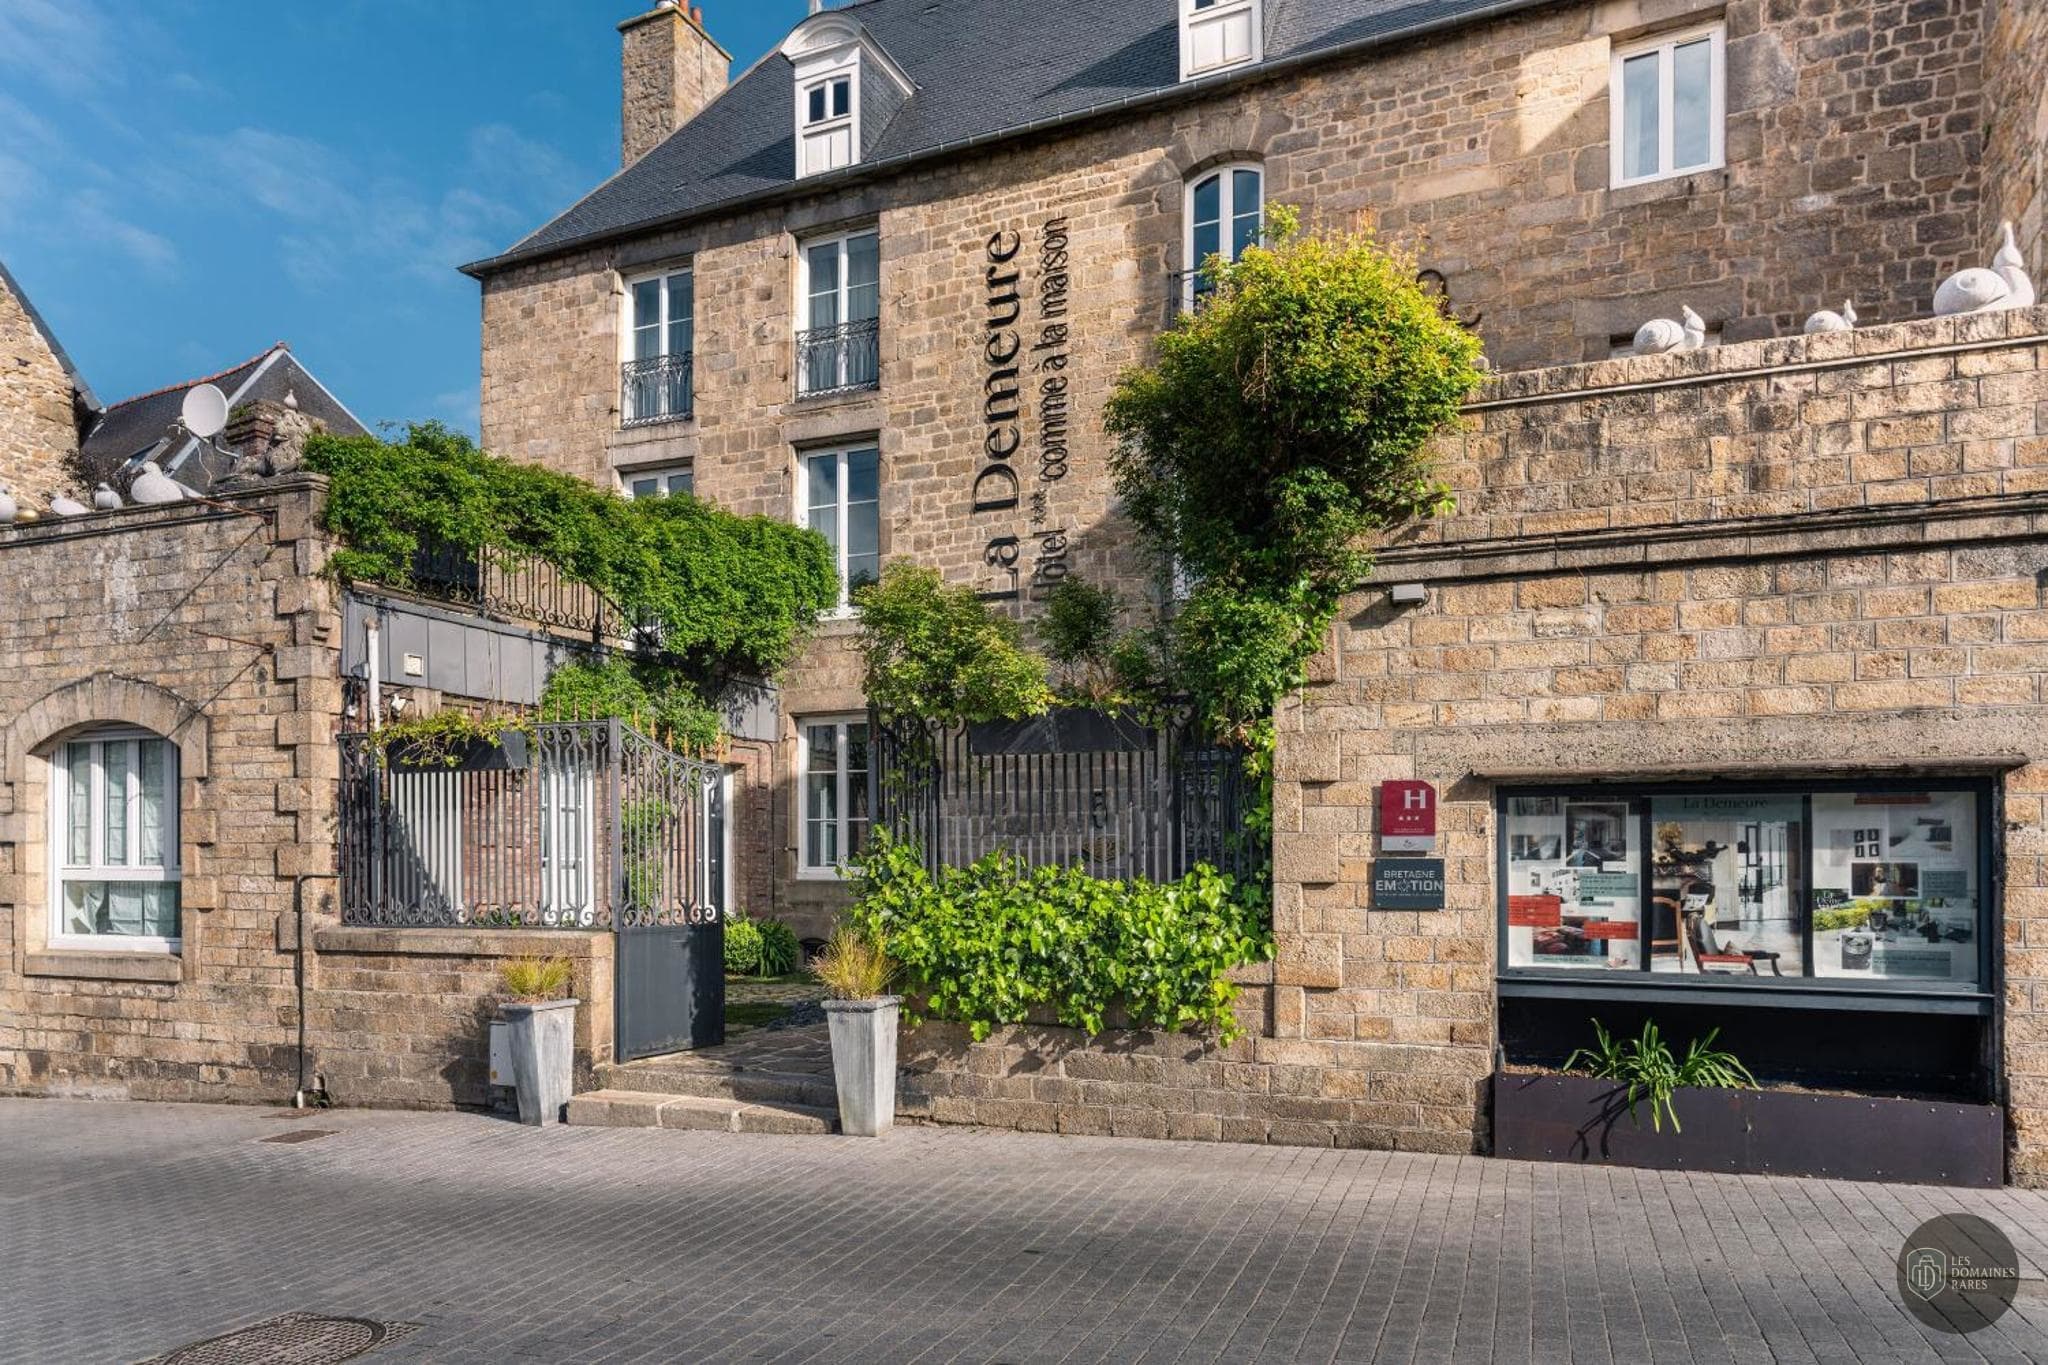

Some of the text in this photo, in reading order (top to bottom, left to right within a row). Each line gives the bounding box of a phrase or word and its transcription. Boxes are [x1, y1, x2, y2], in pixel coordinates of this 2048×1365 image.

[1036, 216, 1068, 320] maison
[1031, 322, 1068, 352] la
[1032, 353, 1068, 374] à
[970, 229, 1021, 601] La Demeure
[1039, 376, 1068, 482] comme
[1404, 790, 1426, 809] H
[1383, 870, 1436, 879] BRETAGNE
